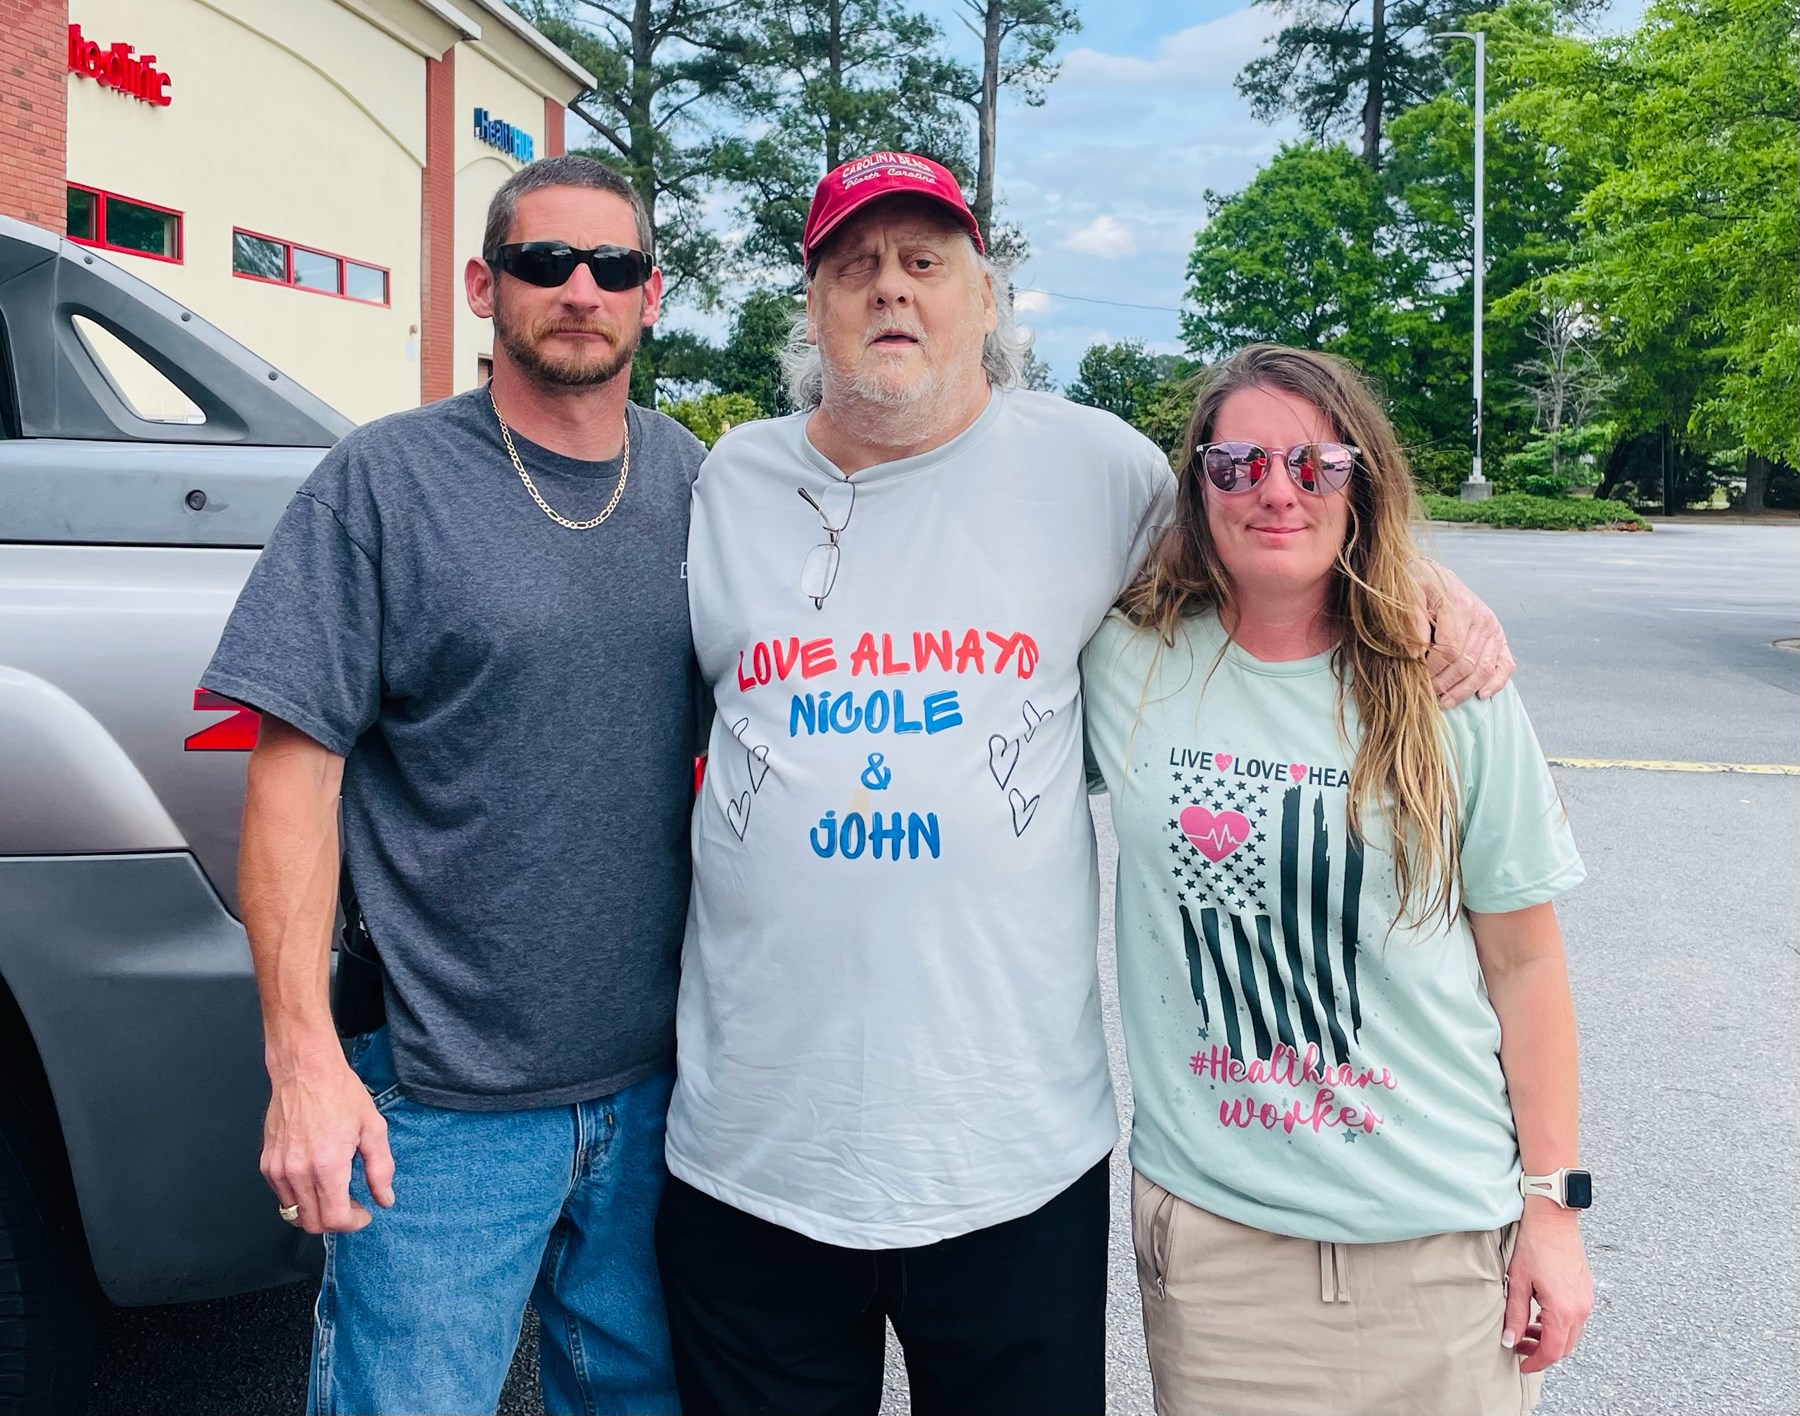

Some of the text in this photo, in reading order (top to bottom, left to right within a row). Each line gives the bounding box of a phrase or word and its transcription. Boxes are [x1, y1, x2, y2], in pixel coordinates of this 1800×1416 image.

[842, 152, 934, 179] CAROLINA BEACH
[844, 167, 937, 190] North Carolina
[737, 637, 838, 693] LOVE
[860, 752, 892, 791] &
[1169, 747, 1350, 788] LIVE LOVE HEA
